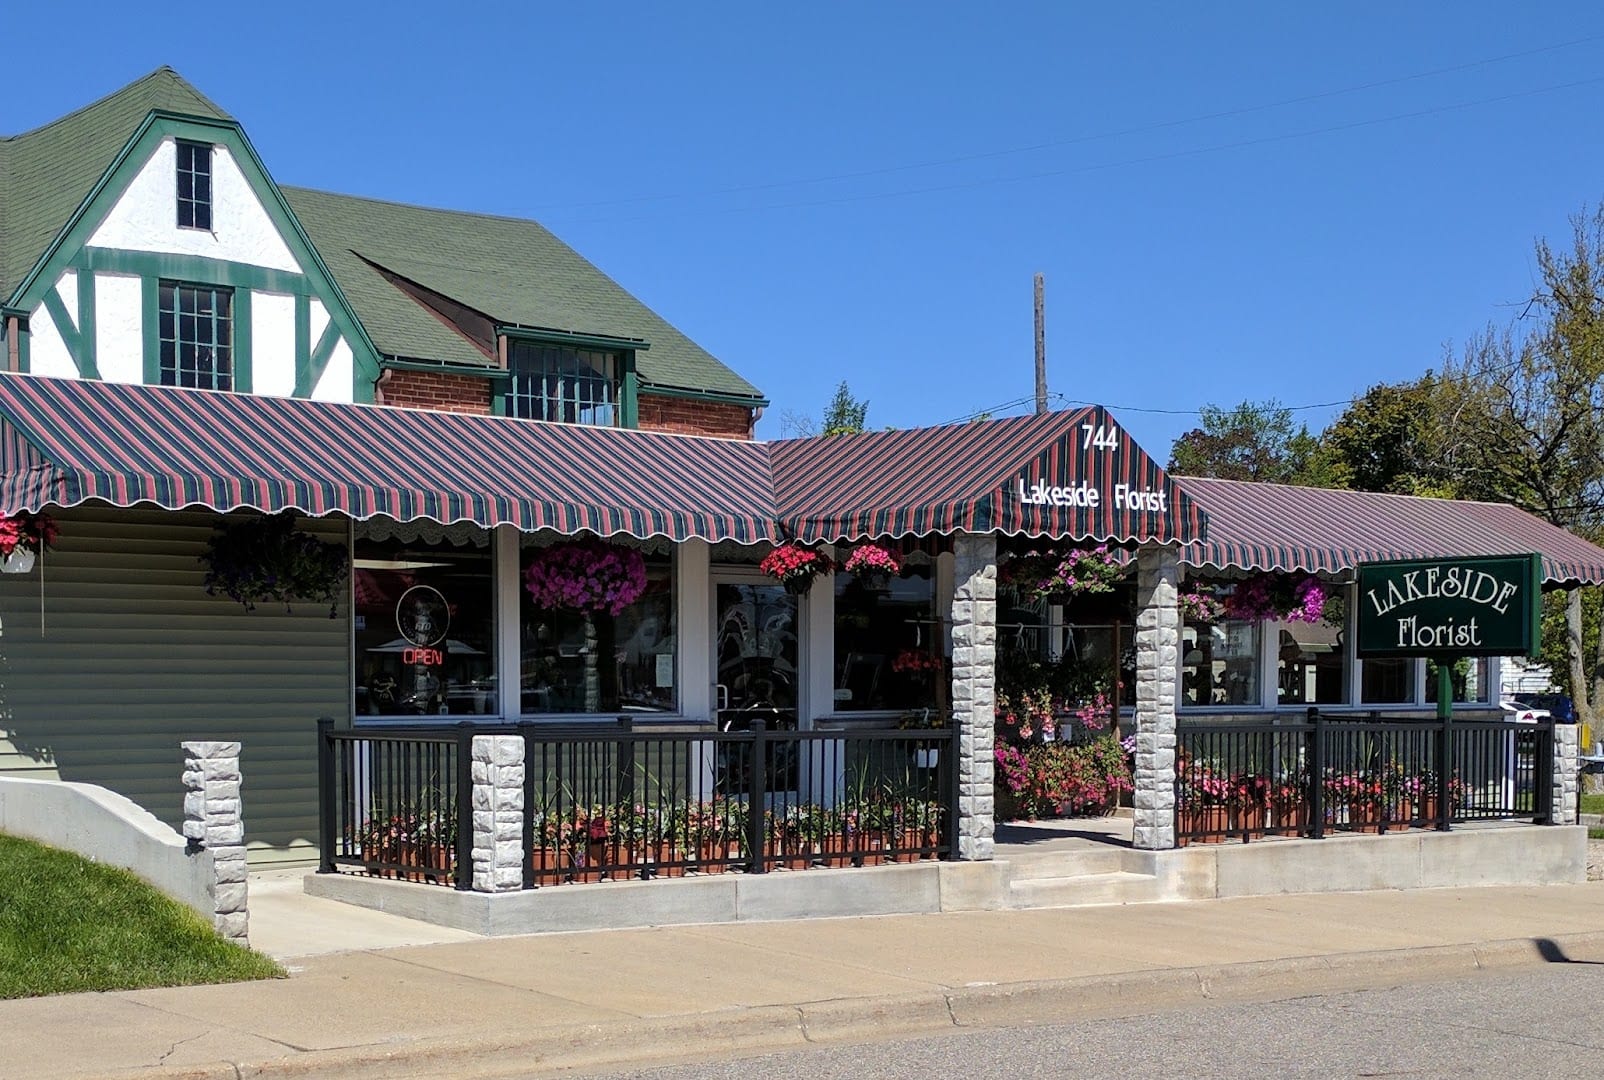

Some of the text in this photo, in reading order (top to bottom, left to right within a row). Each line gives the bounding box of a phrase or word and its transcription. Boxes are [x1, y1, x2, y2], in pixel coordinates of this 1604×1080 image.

[1082, 424, 1118, 451] 744
[1019, 478, 1167, 512] Lakeside Florist
[1367, 566, 1518, 616] LAKESIDE
[1397, 615, 1481, 647] Florist
[403, 648, 443, 665] OPEN
